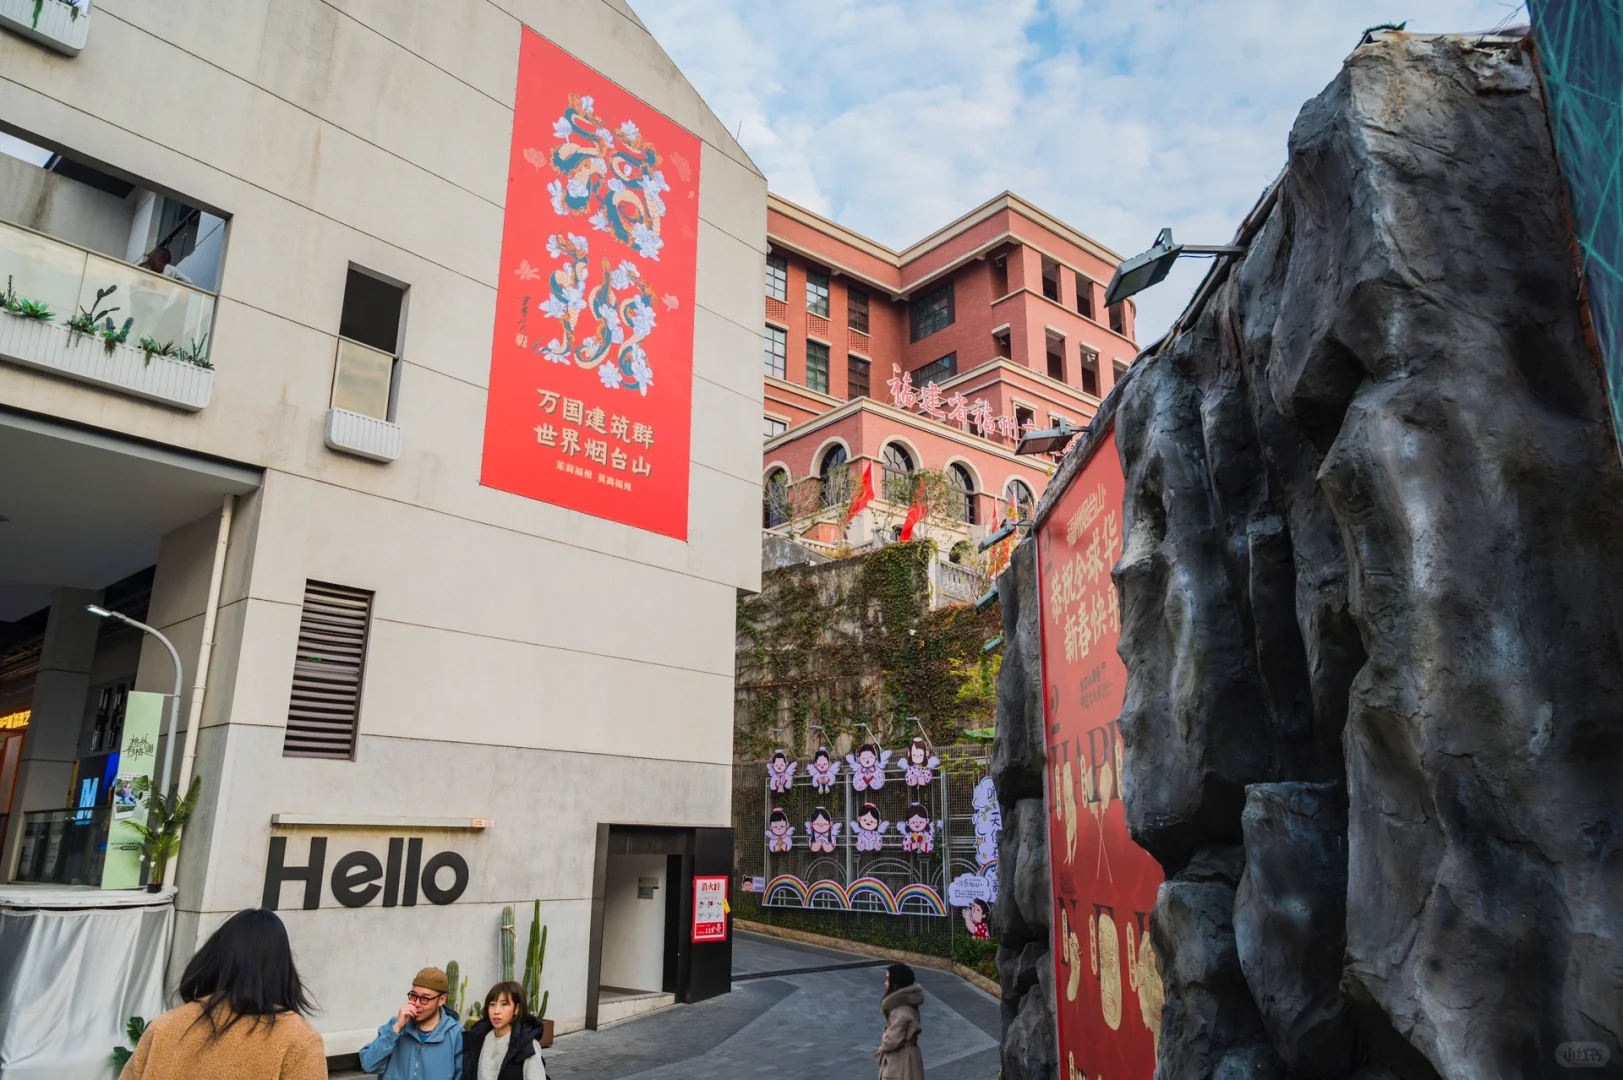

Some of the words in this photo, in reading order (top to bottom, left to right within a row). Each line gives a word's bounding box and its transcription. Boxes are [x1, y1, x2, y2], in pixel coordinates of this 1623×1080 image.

[533, 423, 652, 477] 世界烟台山
[536, 388, 655, 450] 万国建筑群
[1050, 509, 1123, 625] 恭祝全球华
[1064, 583, 1120, 665] 新春快乐
[262, 836, 469, 911] Hello
